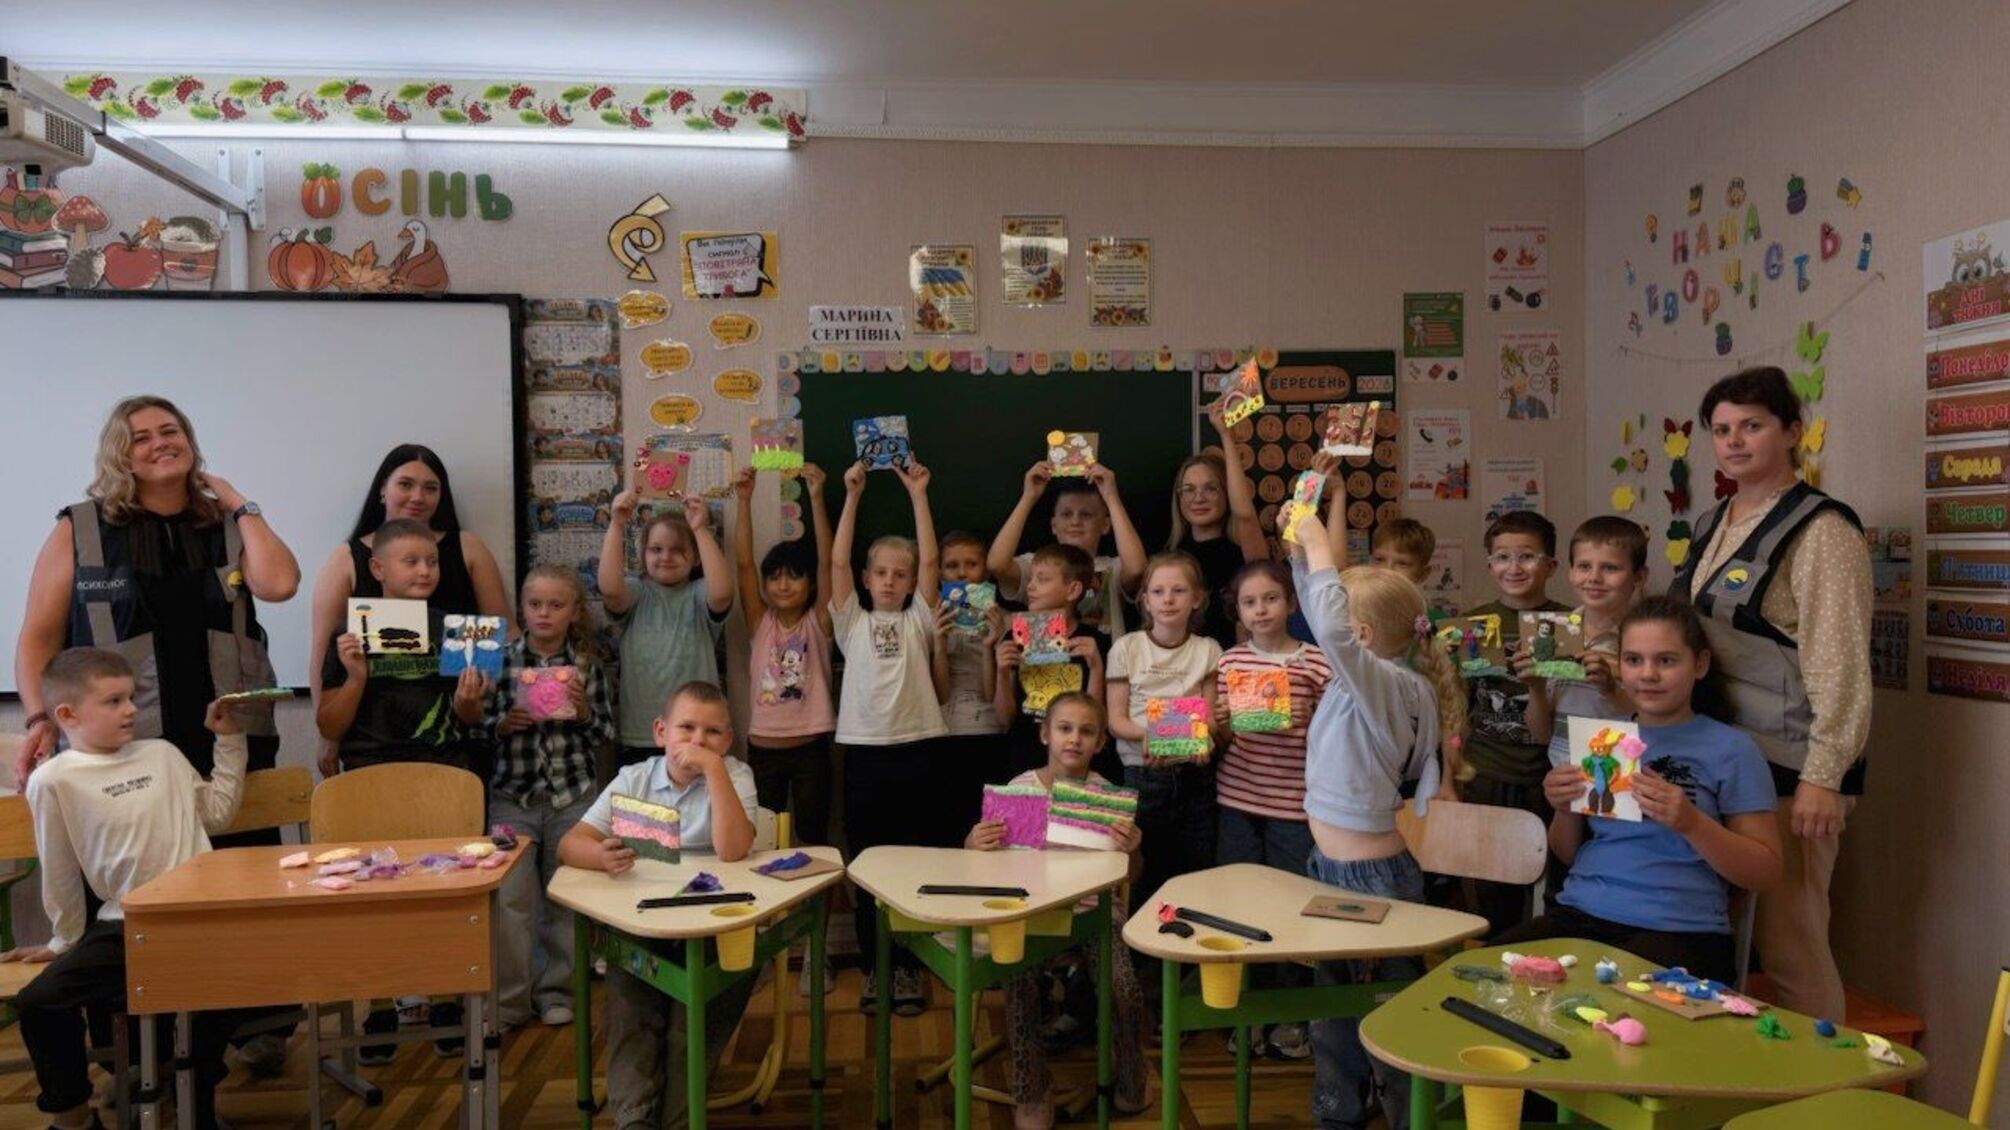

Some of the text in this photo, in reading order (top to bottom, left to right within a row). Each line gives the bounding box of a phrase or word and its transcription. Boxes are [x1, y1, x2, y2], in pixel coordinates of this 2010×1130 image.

[301, 162, 512, 221] ОСІНЬ
[821, 310, 893, 321] МАРИНА
[812, 327, 901, 340] СЕРГІЇВНА
[1271, 376, 1346, 389] ВЕРЕСЕНЬ
[1946, 501, 2006, 528] Четвер
[1946, 607, 2006, 634] Субота
[1945, 662, 2007, 691] Неділя
